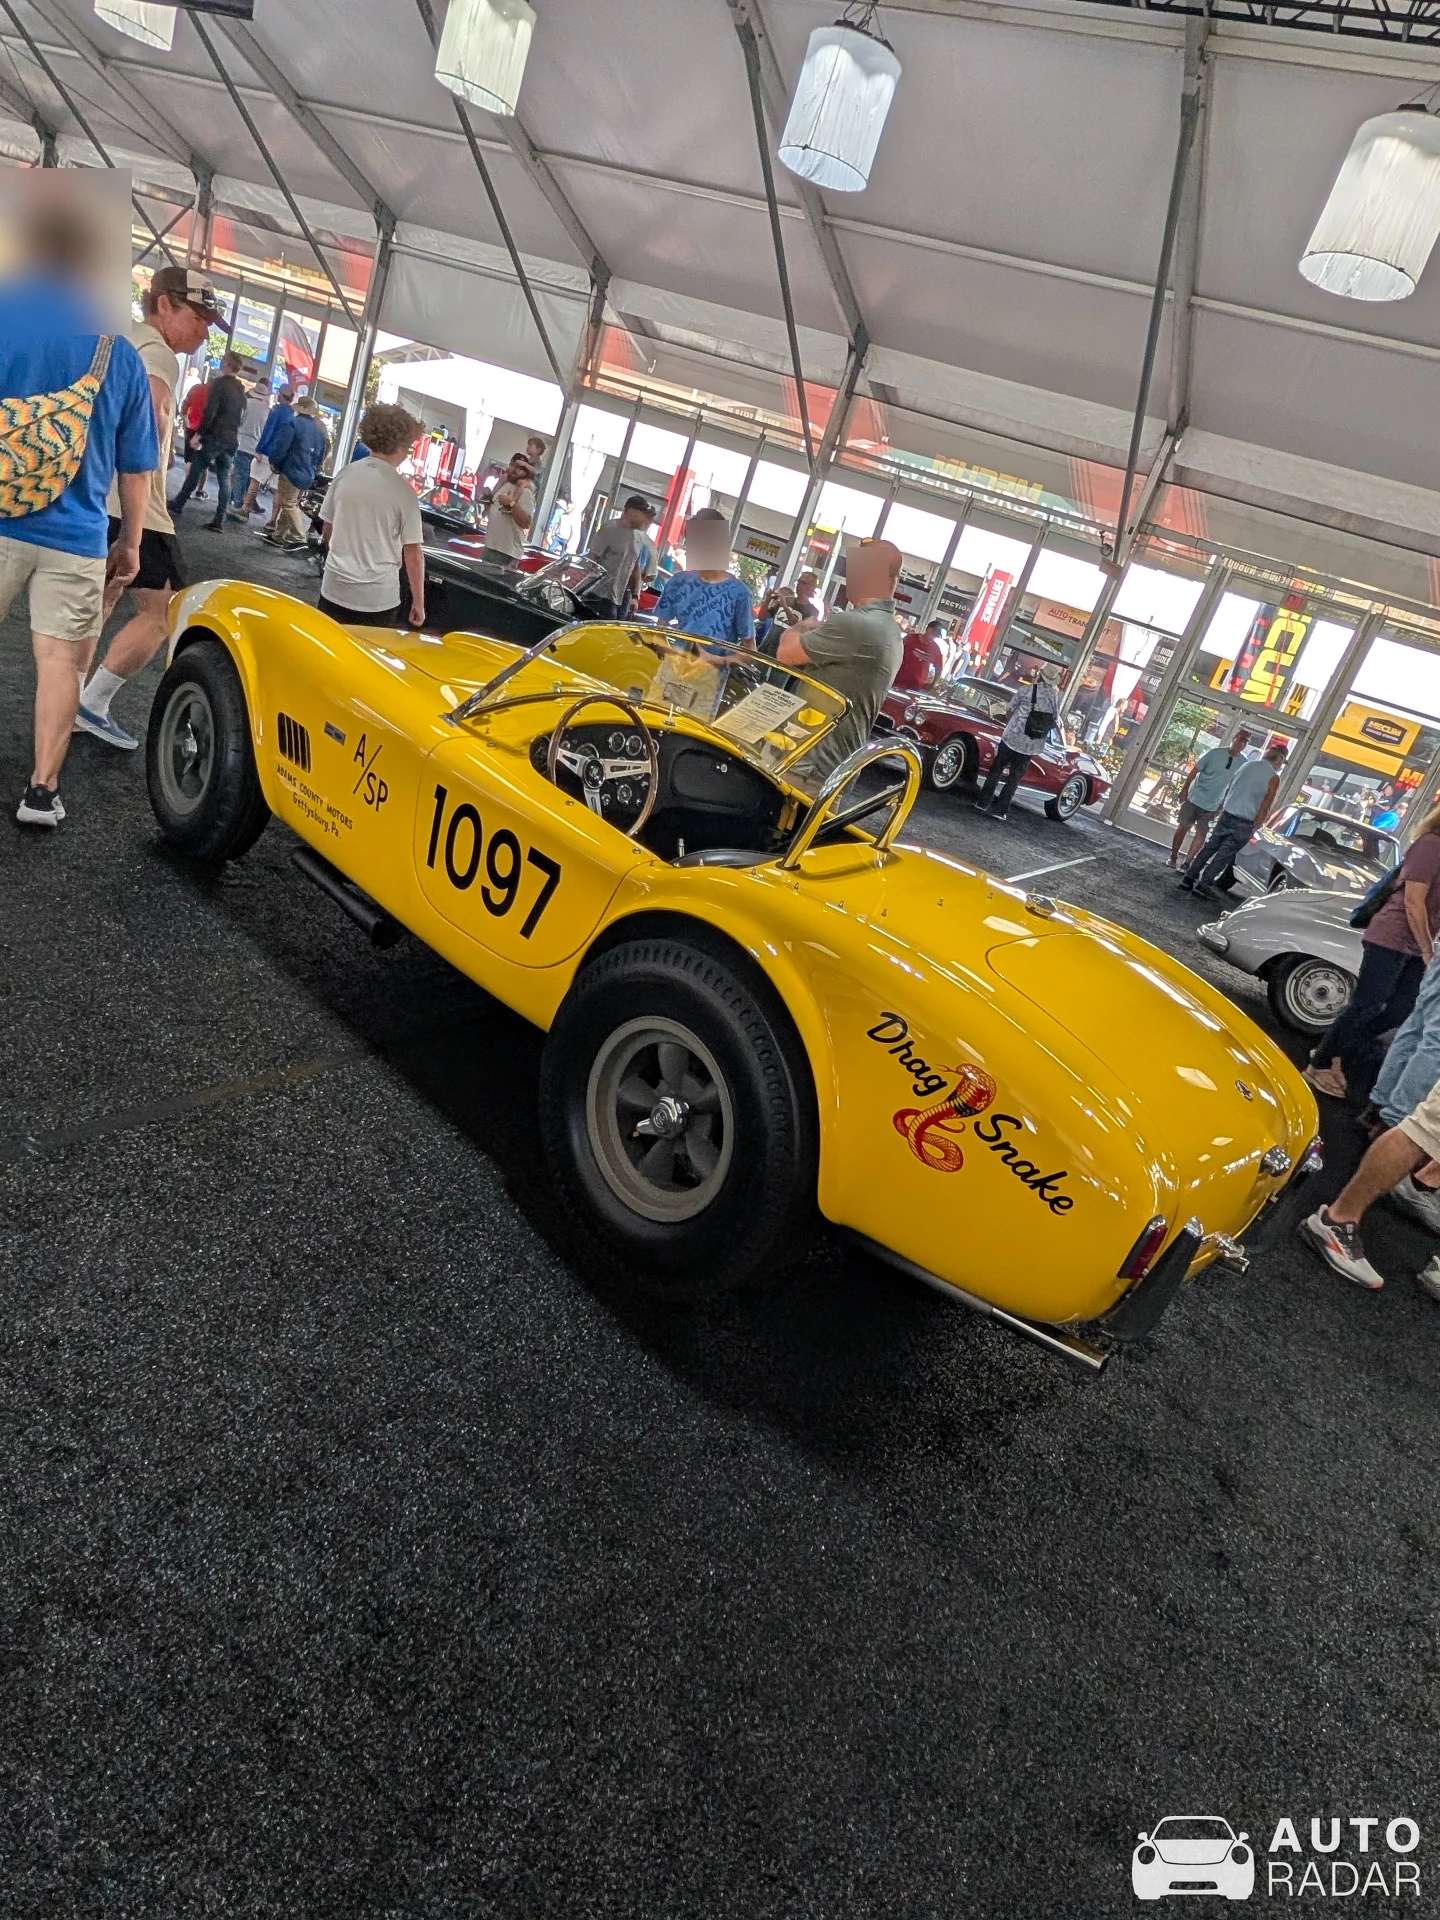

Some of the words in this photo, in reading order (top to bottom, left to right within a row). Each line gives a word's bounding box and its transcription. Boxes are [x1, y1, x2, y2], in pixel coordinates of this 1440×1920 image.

[693, 598, 723, 621] Hurley
[980, 578, 1004, 624] ENTRANCE
[1049, 608, 1068, 620] AUTO
[1368, 720, 1402, 737] MECUM
[276, 764, 297, 788] ADAMS
[299, 781, 324, 809] COUNTY
[326, 803, 354, 831] MOTORS
[426, 783, 562, 940] 1097
[866, 1011, 949, 1097] Drag
[973, 1113, 1075, 1217] Snake
